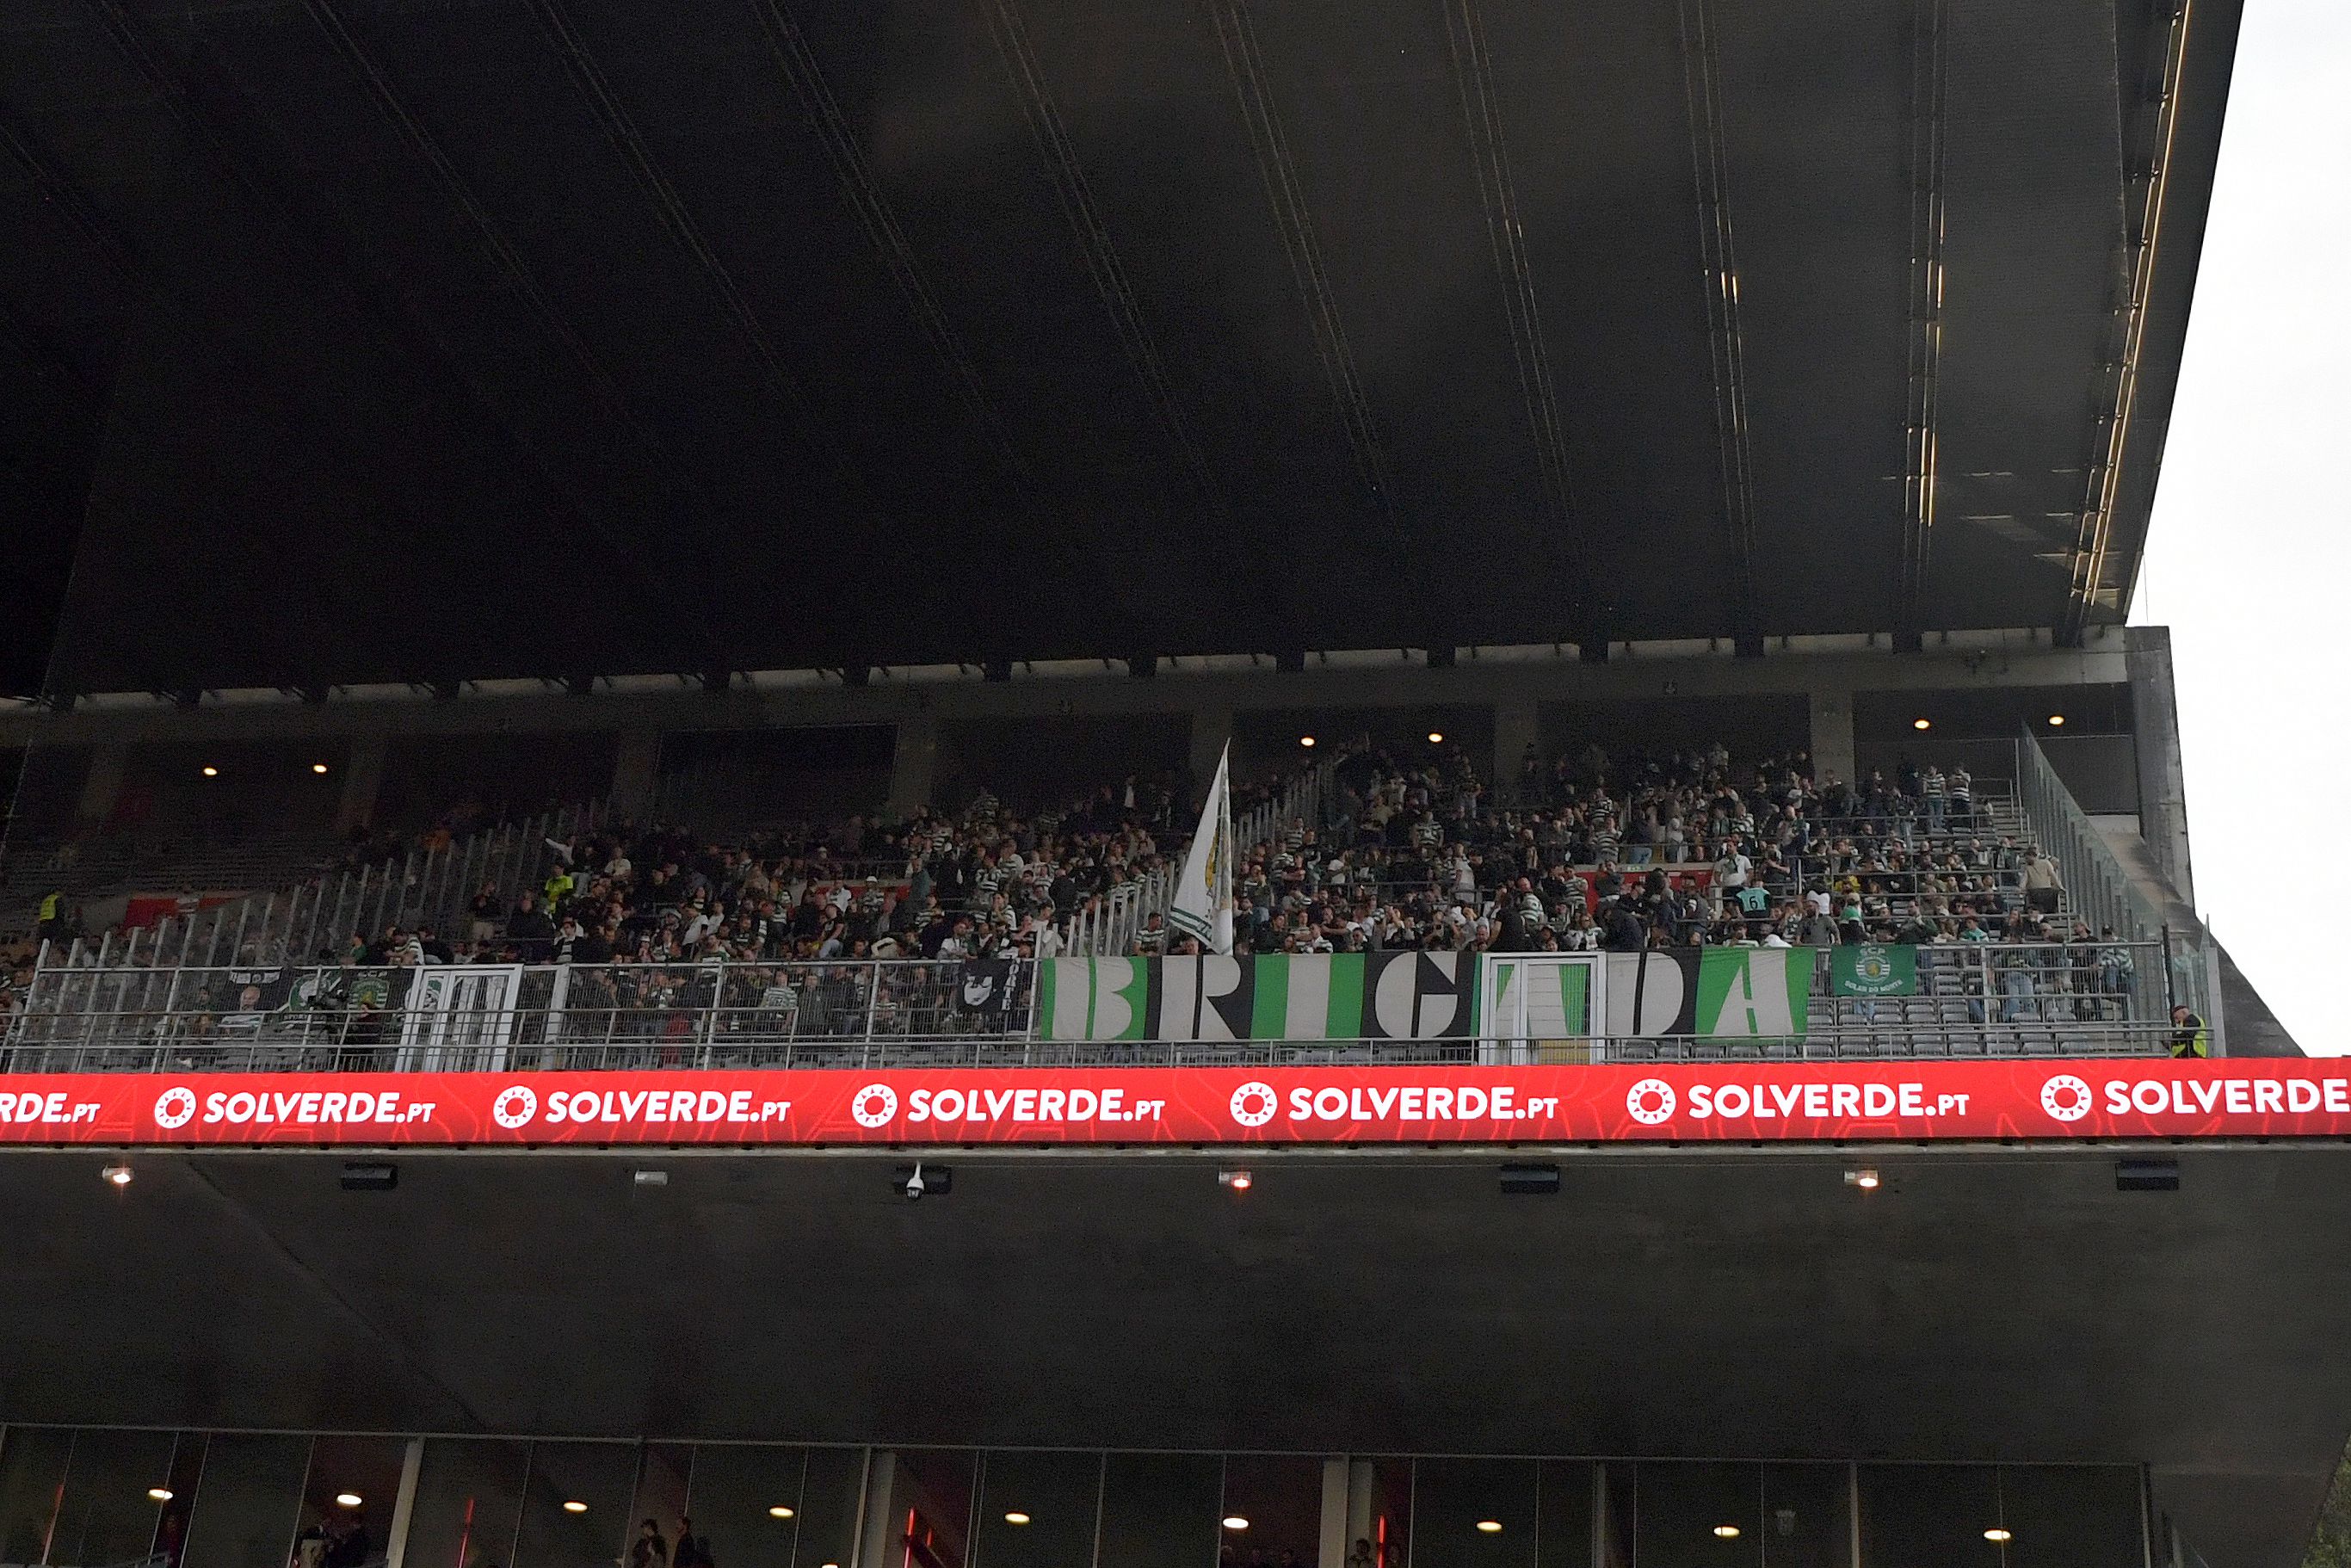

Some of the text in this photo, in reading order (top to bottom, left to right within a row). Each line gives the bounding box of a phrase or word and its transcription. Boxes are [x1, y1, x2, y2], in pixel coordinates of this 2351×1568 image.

[1749, 896, 1757, 910] 6
[1051, 949, 1794, 1040] BRIGADA
[203, 1092, 435, 1123] SOLVERDE.PT
[546, 1090, 791, 1123] SOLVERDE.PT
[908, 1089, 1165, 1122] SOLVERDE.PT
[1289, 1087, 1558, 1120] SOLVERDE.PT
[1688, 1083, 1969, 1119] SOLVERDE.PT
[2105, 1078, 2350, 1114] SOLVERDE
